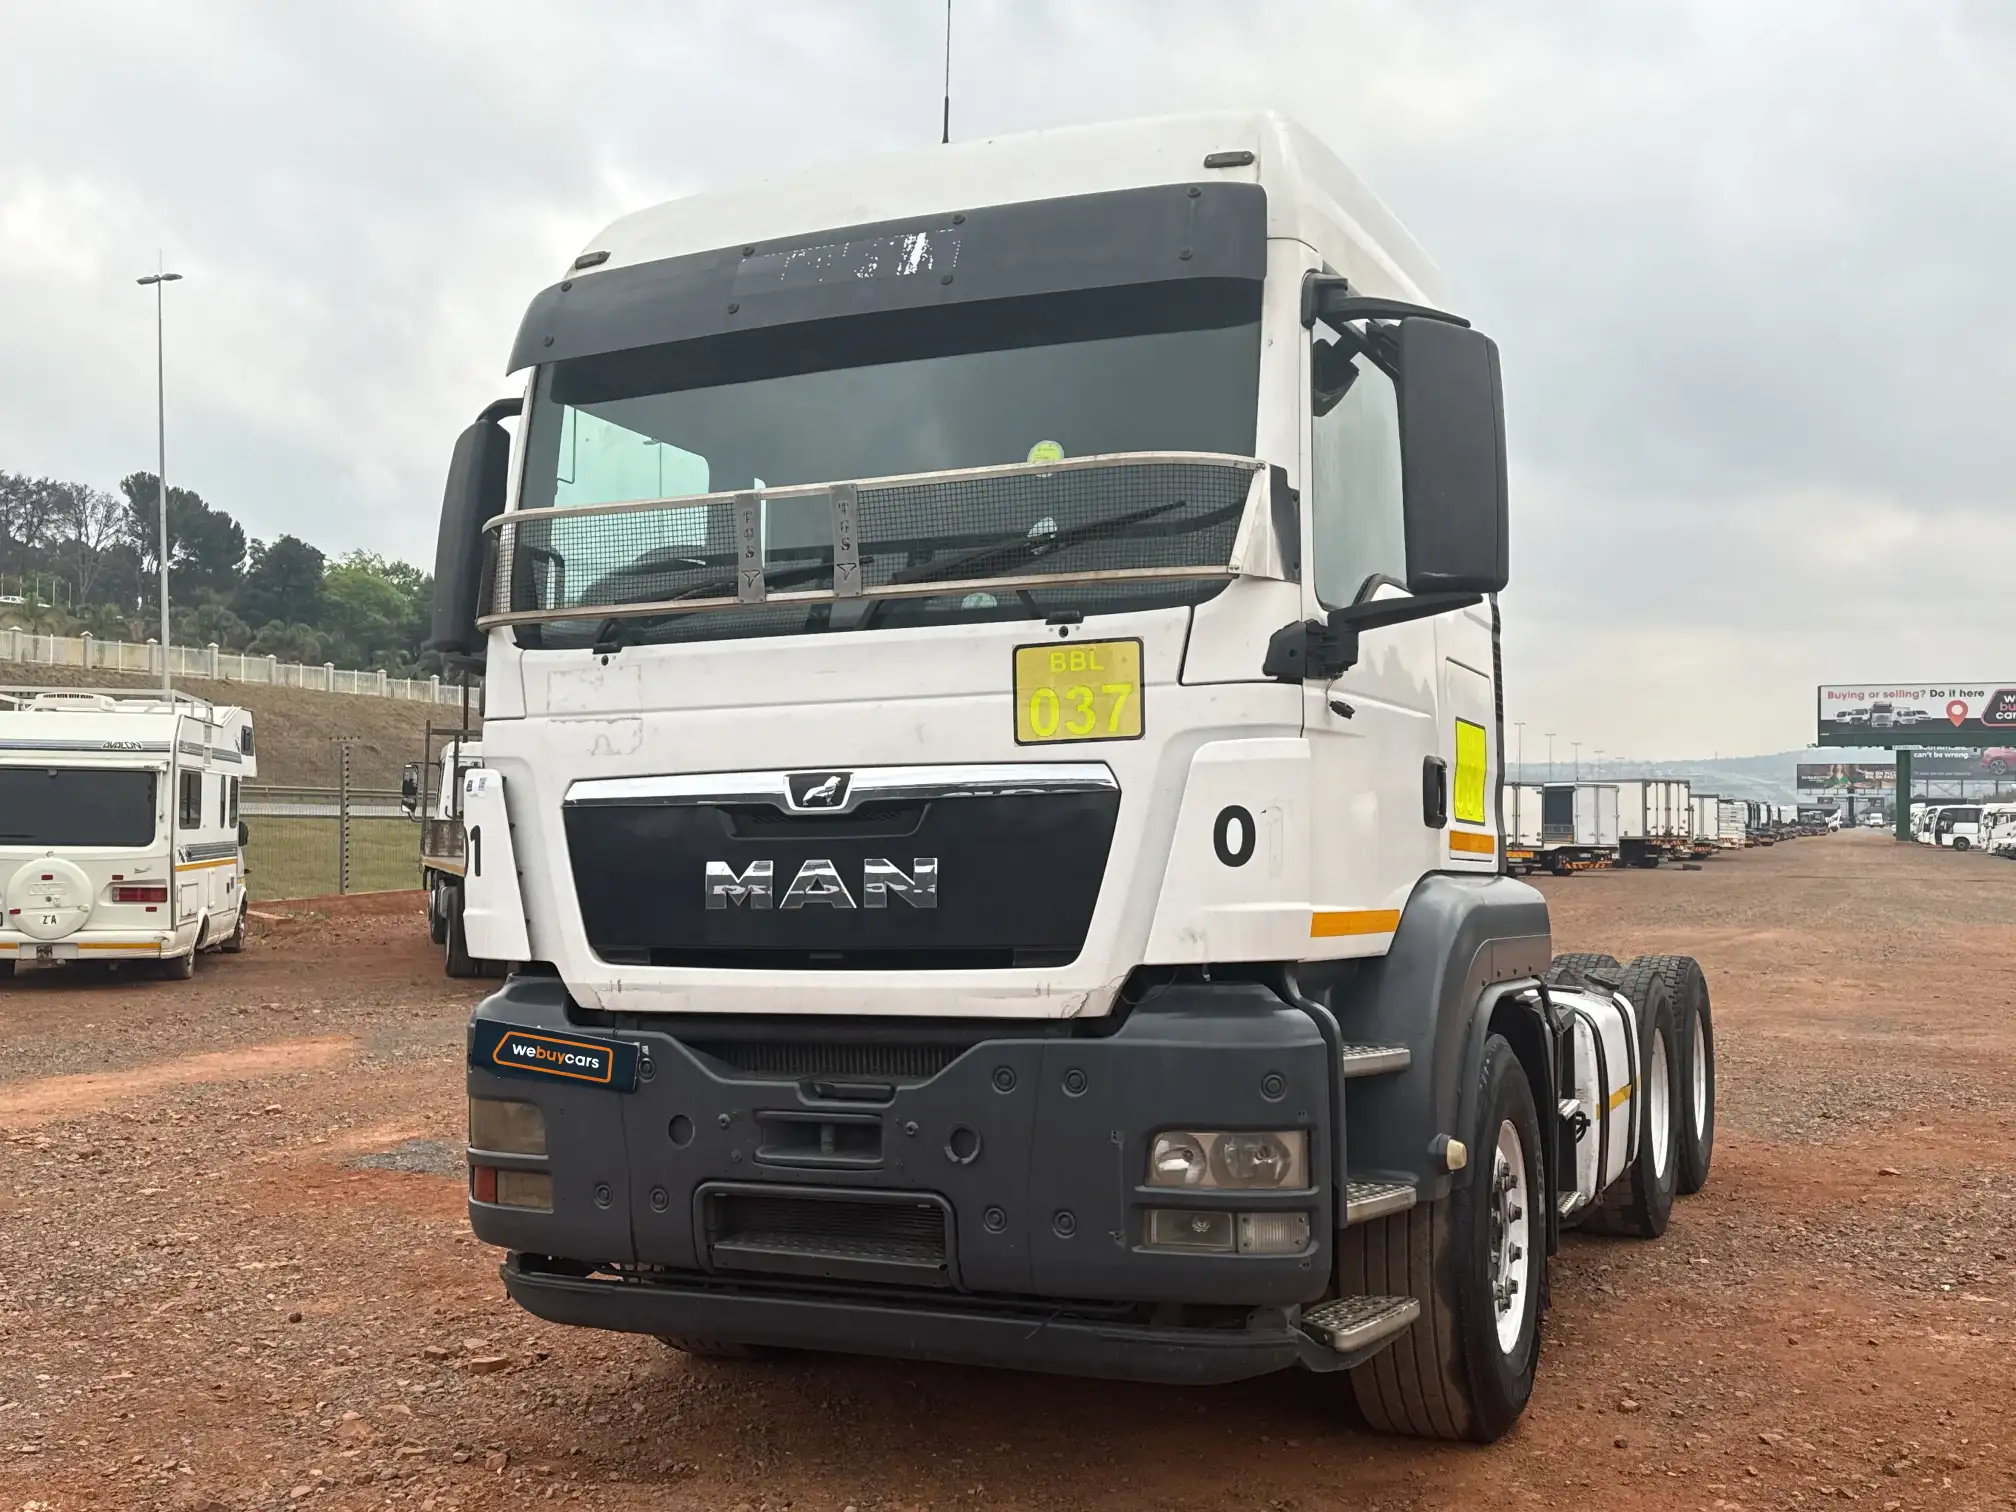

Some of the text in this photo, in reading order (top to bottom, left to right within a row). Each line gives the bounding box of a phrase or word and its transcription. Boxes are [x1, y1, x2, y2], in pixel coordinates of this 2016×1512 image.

[1050, 649, 1105, 673] BBL
[1029, 683, 1134, 737] 037
[1827, 690, 1865, 701] Buying
[1883, 689, 1926, 700] selling?
[1929, 689, 1945, 698] Do
[1949, 688, 1956, 698] it
[1959, 689, 1985, 698] here
[102, 740, 142, 750] AVALON
[464, 825, 481, 877] 1
[1213, 804, 1256, 868] 0
[705, 857, 938, 910] MAN
[511, 1043, 600, 1069] webuycars
